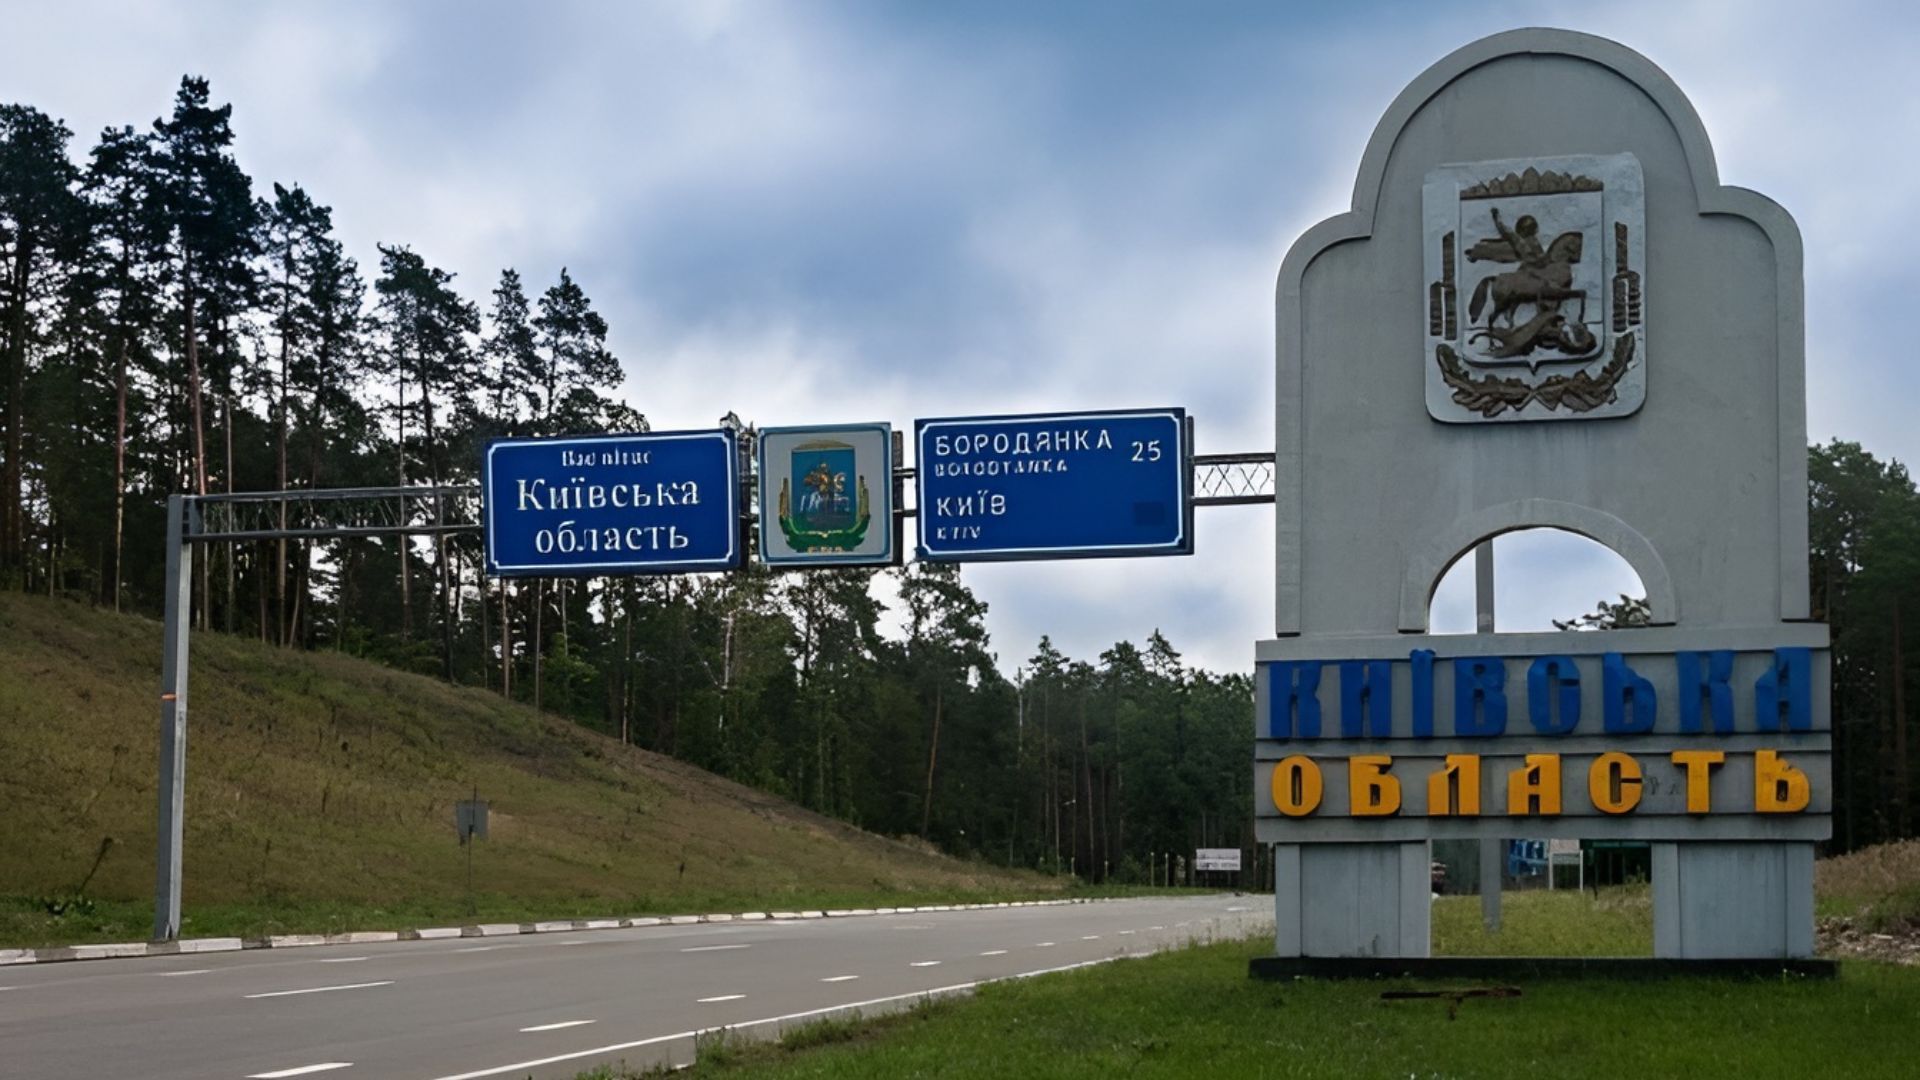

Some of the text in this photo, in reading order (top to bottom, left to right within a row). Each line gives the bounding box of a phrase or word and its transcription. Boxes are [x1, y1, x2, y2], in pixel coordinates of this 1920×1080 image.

[935, 429, 1161, 462] БОРОДЯНКА 25
[516, 477, 699, 511] Київська
[937, 489, 1006, 516] КИЇВ
[535, 520, 689, 554] область
[1271, 750, 1810, 816] ОБЛАСТЬ
